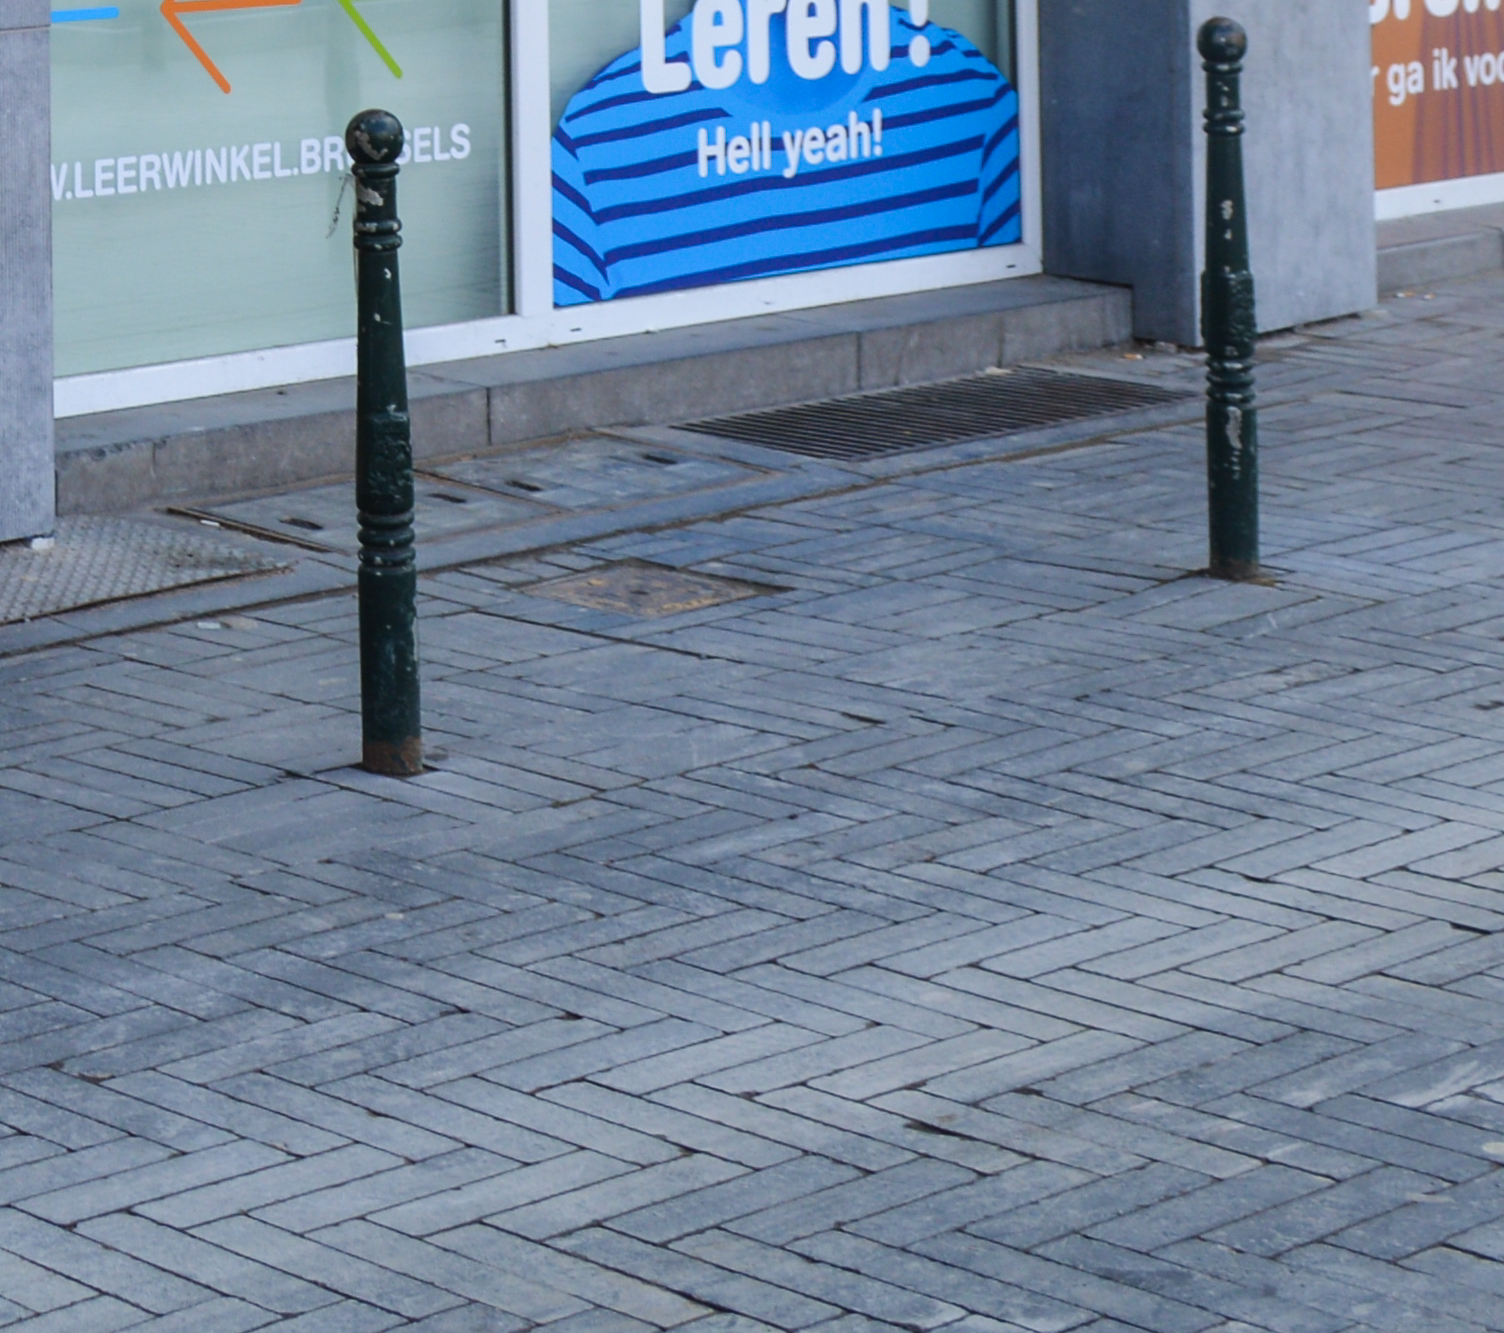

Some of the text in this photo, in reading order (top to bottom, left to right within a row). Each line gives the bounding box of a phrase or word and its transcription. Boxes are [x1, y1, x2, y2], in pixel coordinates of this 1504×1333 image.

[1388, 61, 1424, 106] ga
[1433, 47, 1458, 90] ik
[698, 108, 882, 179] Hell yeah!
